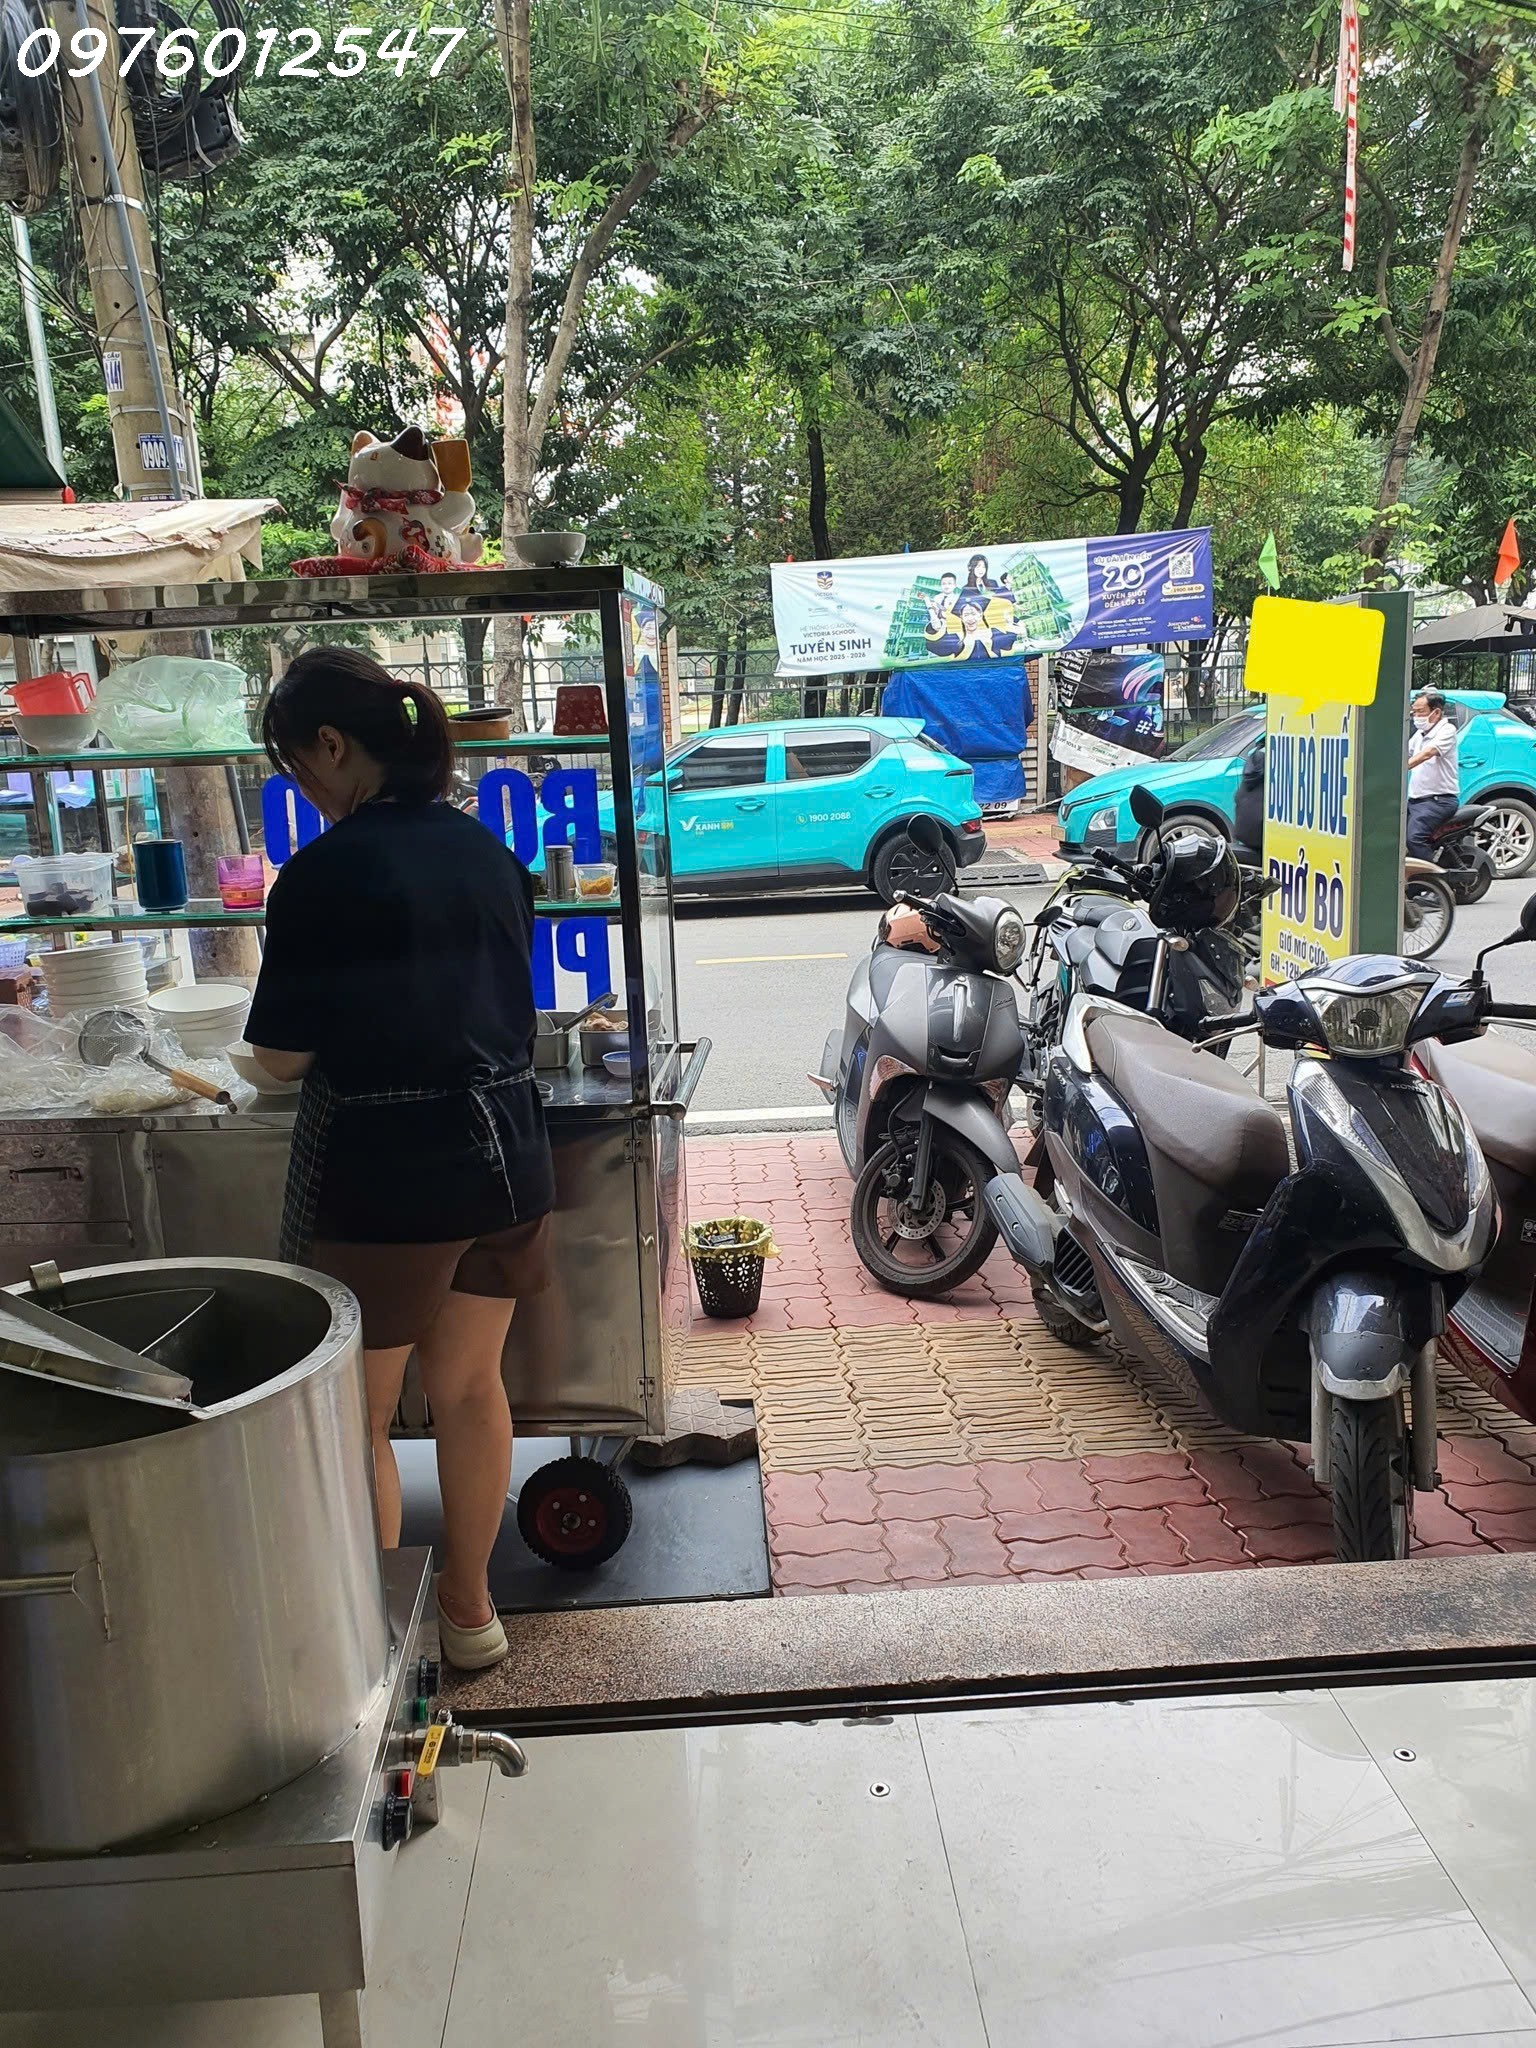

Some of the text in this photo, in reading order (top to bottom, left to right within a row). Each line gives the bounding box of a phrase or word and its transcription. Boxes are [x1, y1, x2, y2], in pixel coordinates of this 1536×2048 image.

[790, 637, 872, 655] TUYỂN SINH
[1268, 705, 1351, 836] BÚN BÒ HUẾ
[696, 823, 720, 831] XANH
[809, 813, 829, 822] 1900
[1268, 847, 1344, 938] PHỞ BÒ
[1279, 930, 1292, 953] GIỜ
[1294, 935, 1307, 960] MỞ
[1270, 953, 1280, 972] 6H
